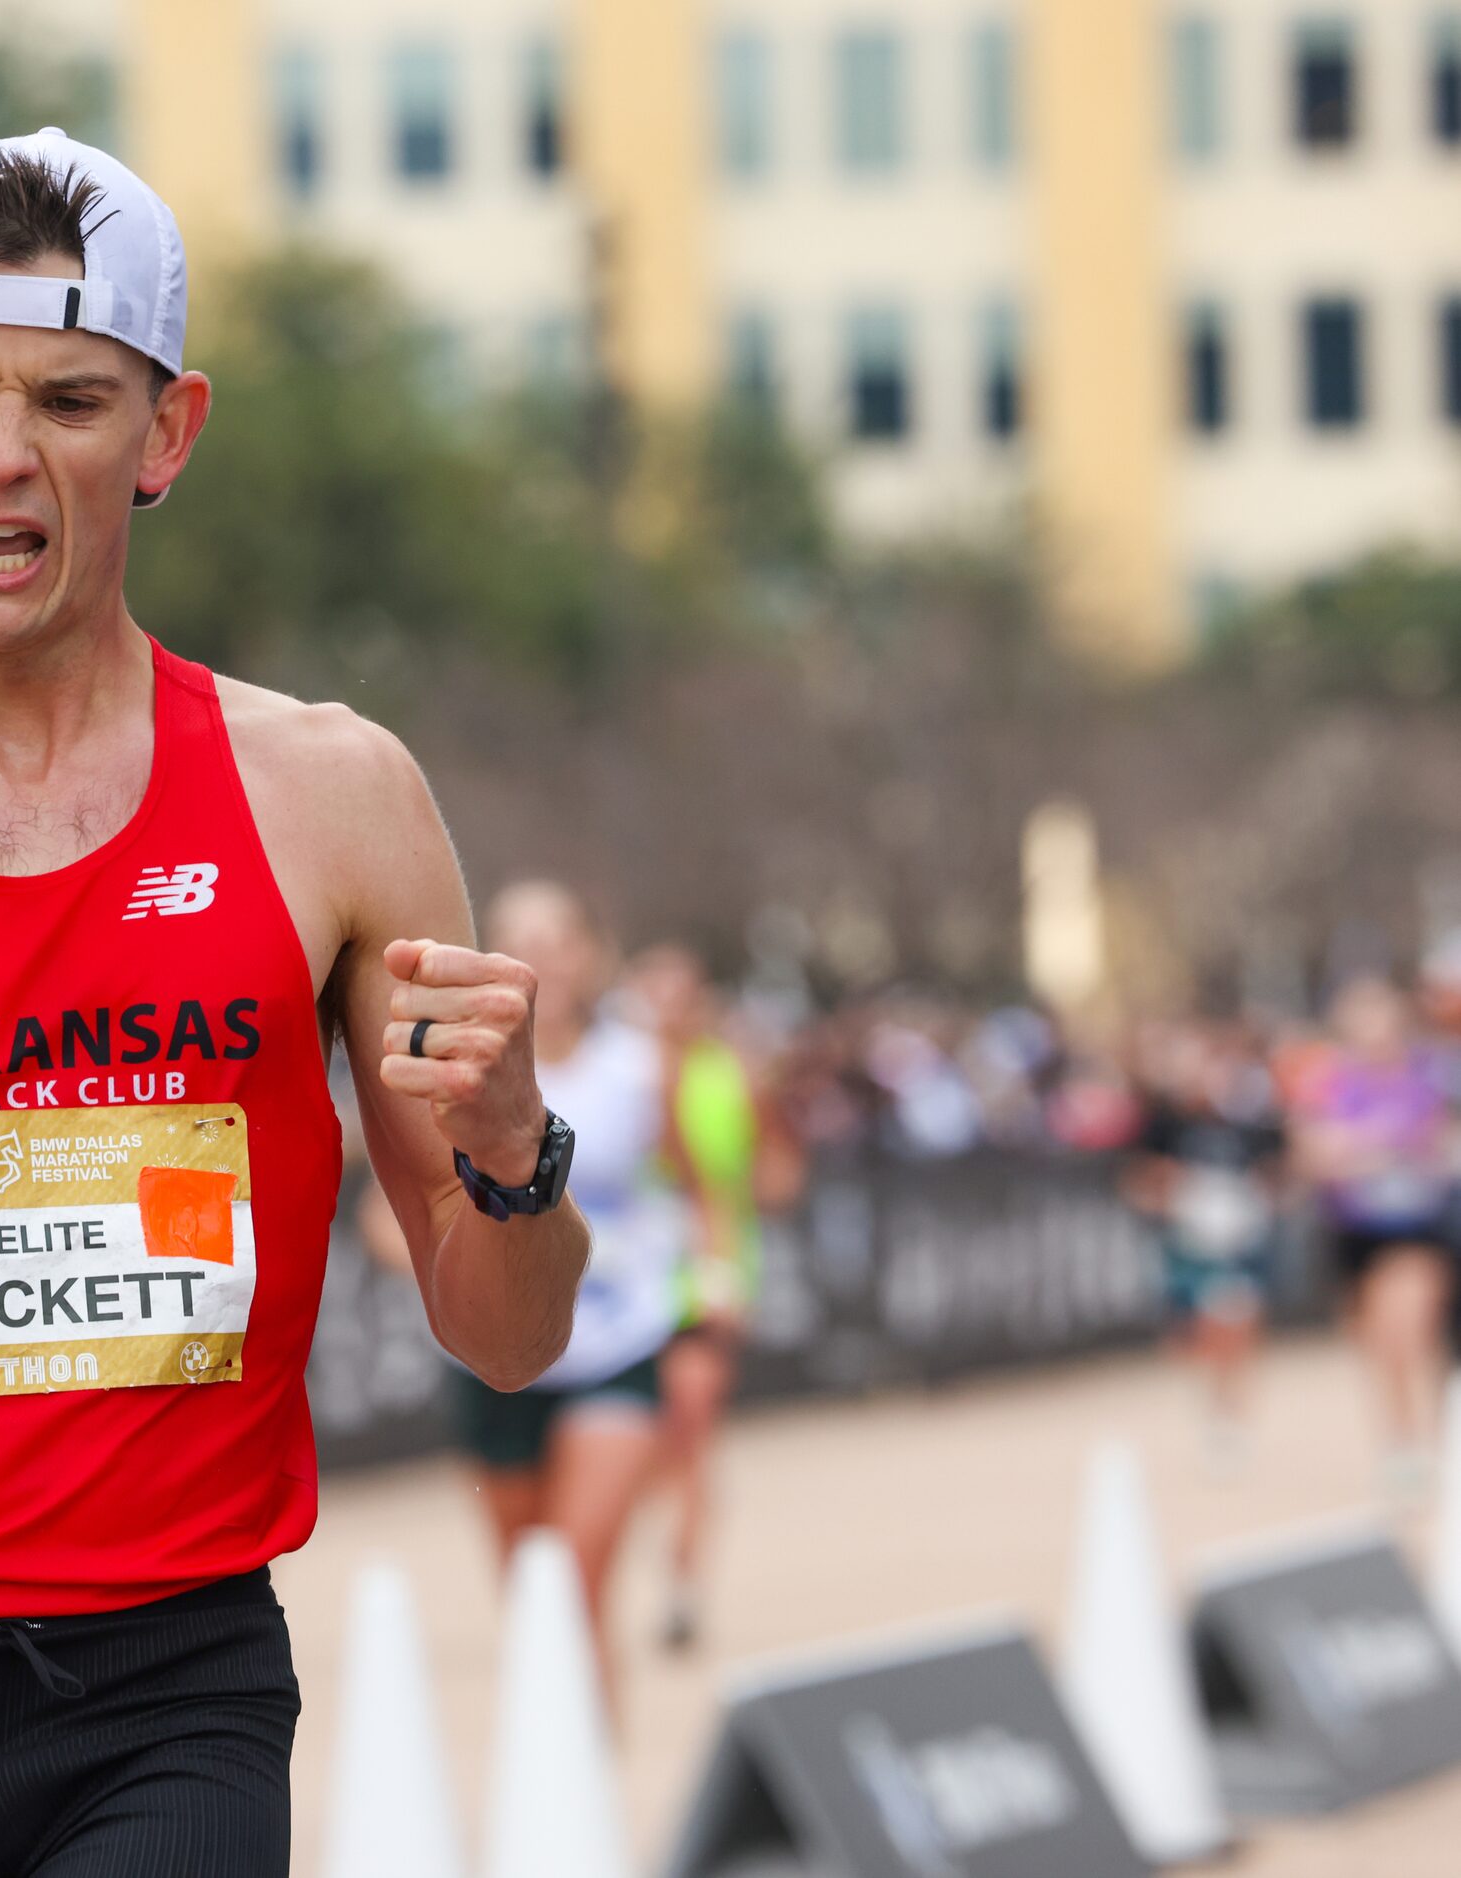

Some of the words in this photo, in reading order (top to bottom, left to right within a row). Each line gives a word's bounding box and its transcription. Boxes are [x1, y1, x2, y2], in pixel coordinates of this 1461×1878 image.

[122, 862, 220, 921] NB
[78, 1071, 186, 1105] CLUB
[30, 1137, 71, 1152] BMW
[75, 1134, 143, 1150] DALLAS
[31, 1150, 128, 1167] MARATHON
[32, 1166, 113, 1183] FESTIVAL
